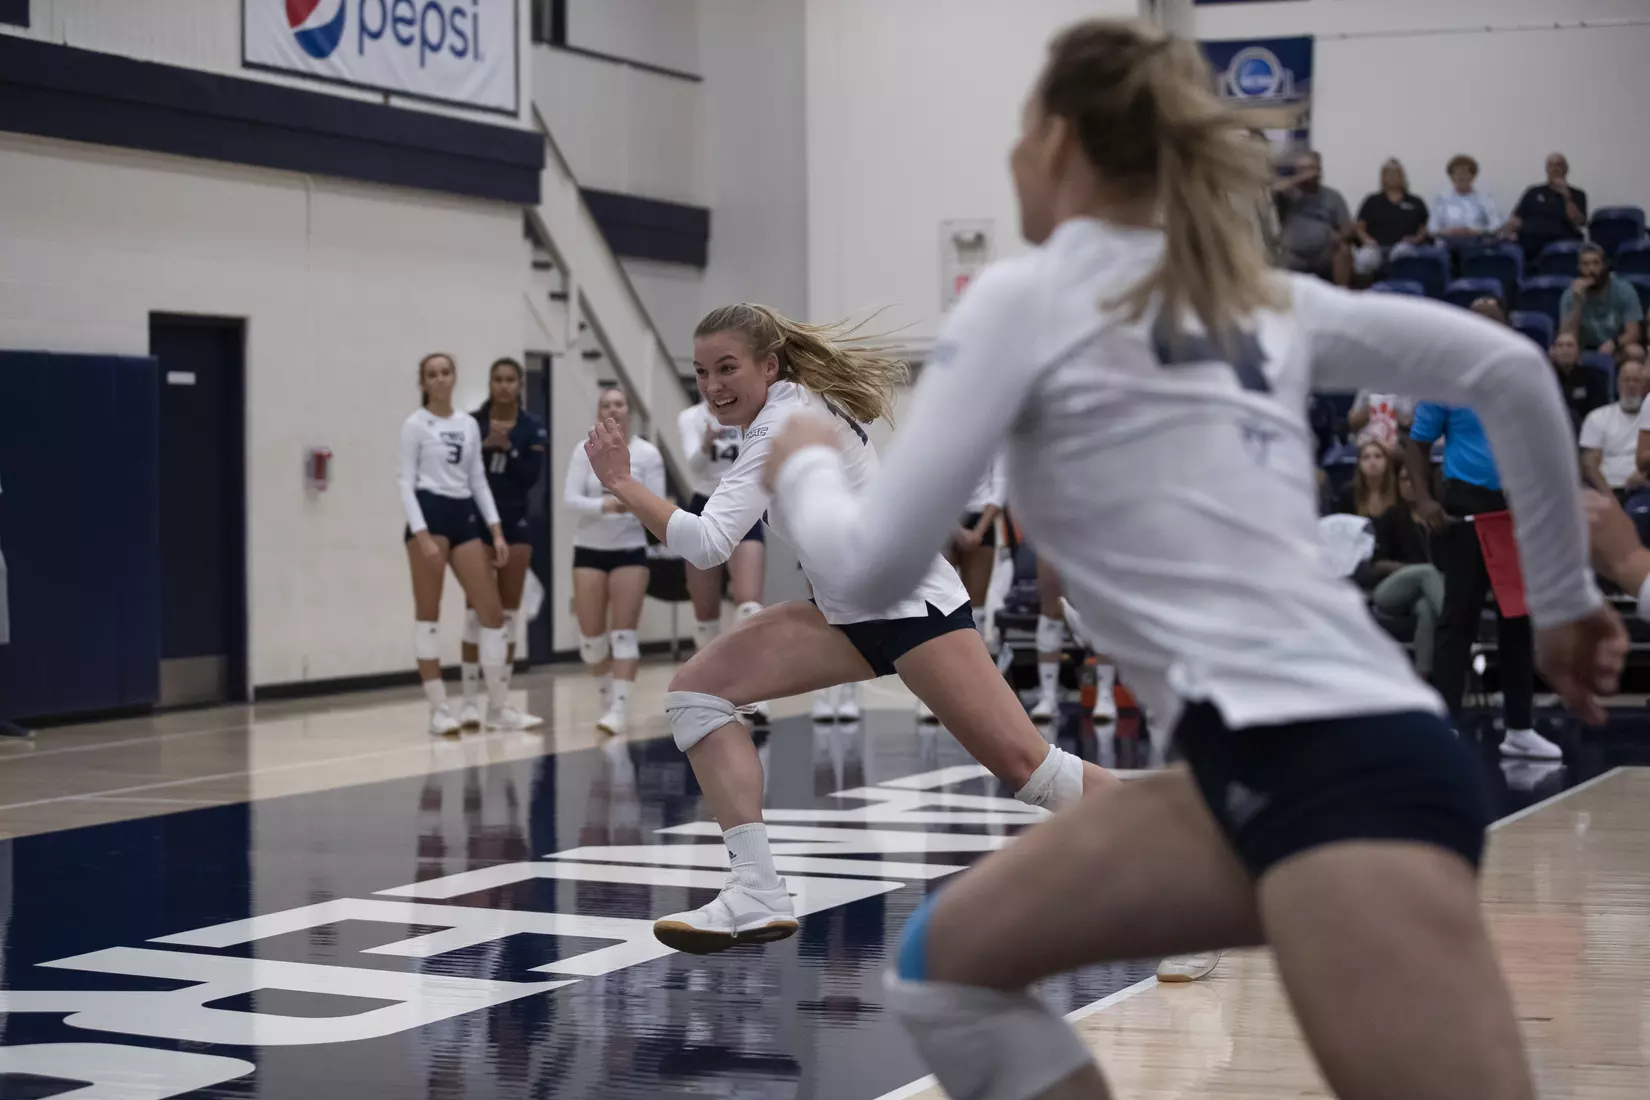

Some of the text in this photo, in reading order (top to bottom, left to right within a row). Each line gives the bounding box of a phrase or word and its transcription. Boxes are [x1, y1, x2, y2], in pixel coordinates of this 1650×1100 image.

[357, 0, 481, 67] pepsi
[445, 442, 463, 464] 3
[710, 444, 739, 463] 14
